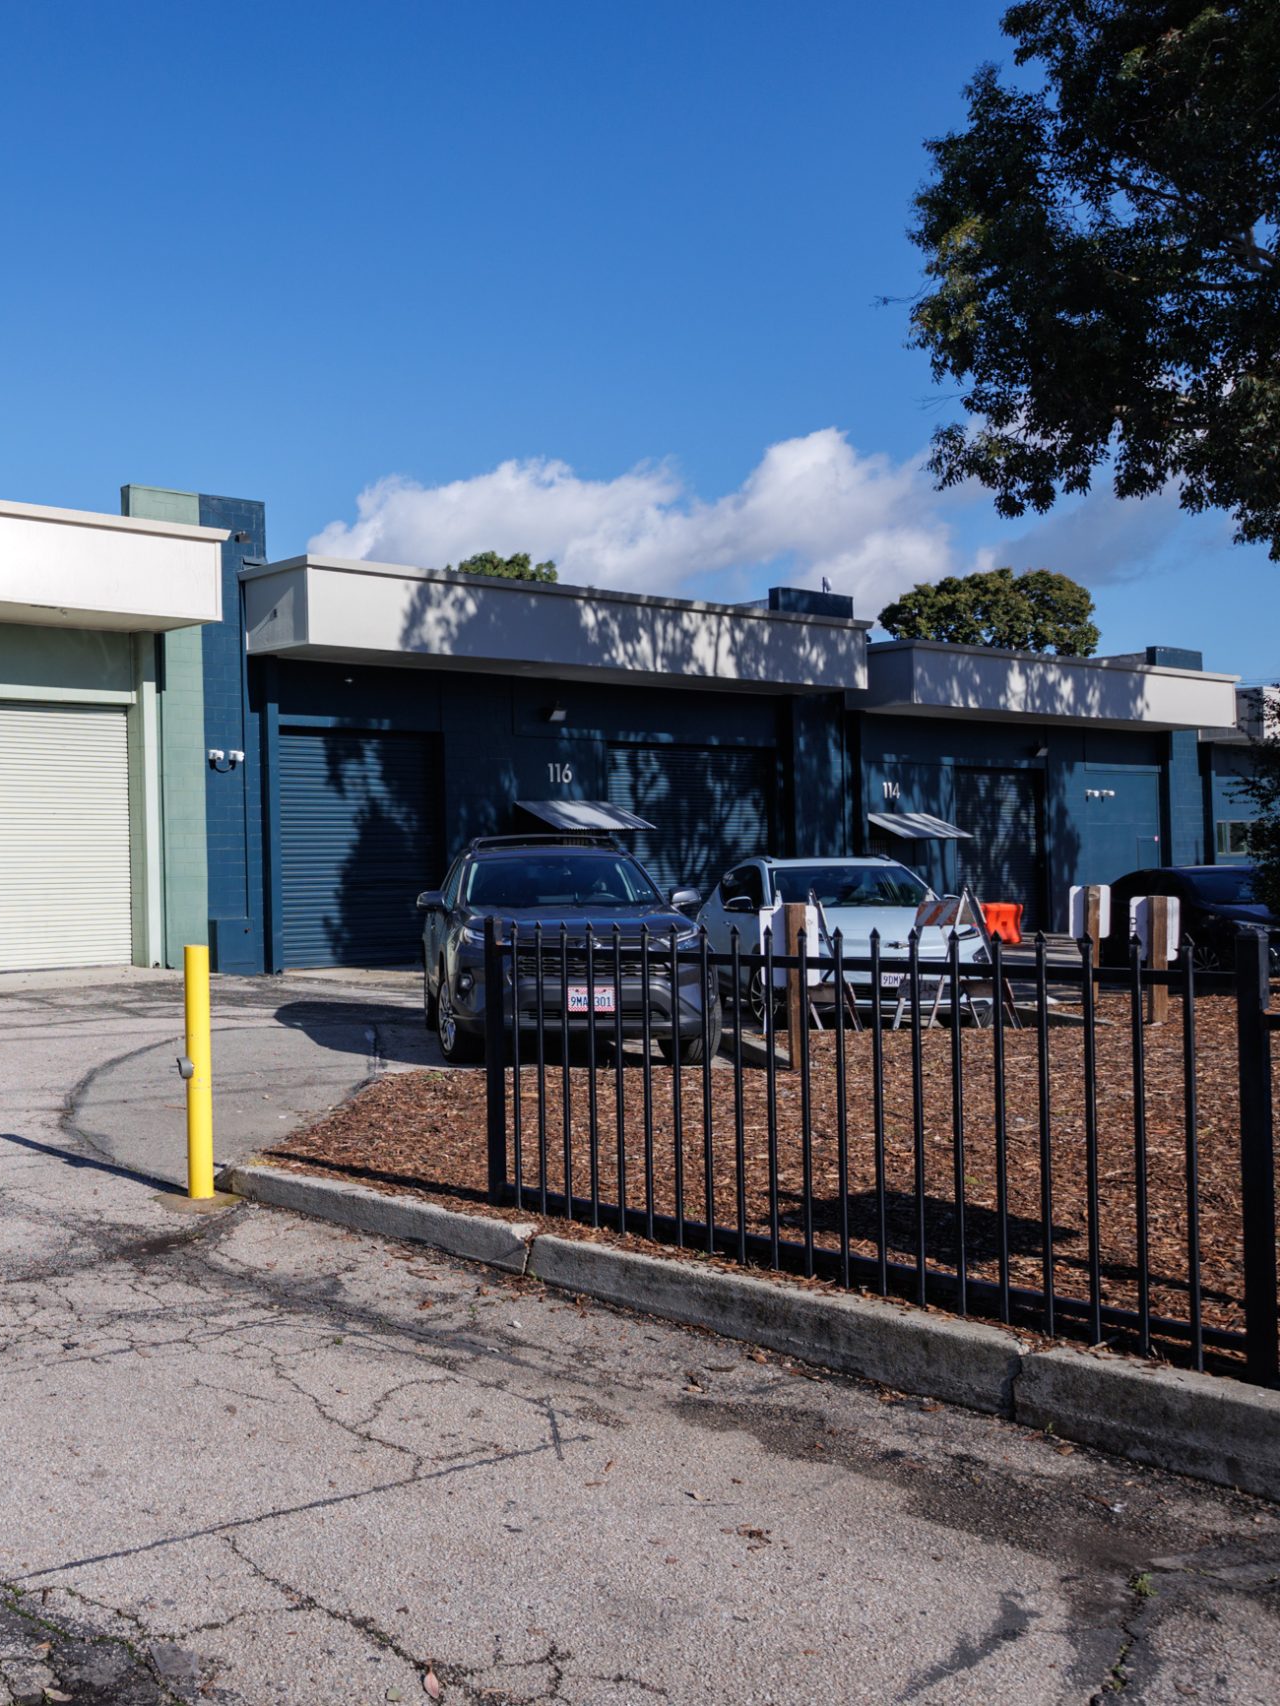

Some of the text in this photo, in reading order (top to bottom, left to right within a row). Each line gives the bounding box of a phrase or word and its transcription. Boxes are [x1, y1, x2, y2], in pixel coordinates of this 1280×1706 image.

[547, 763, 573, 784] 116
[882, 782, 901, 799] 114
[570, 996, 612, 1007] 9MA301
